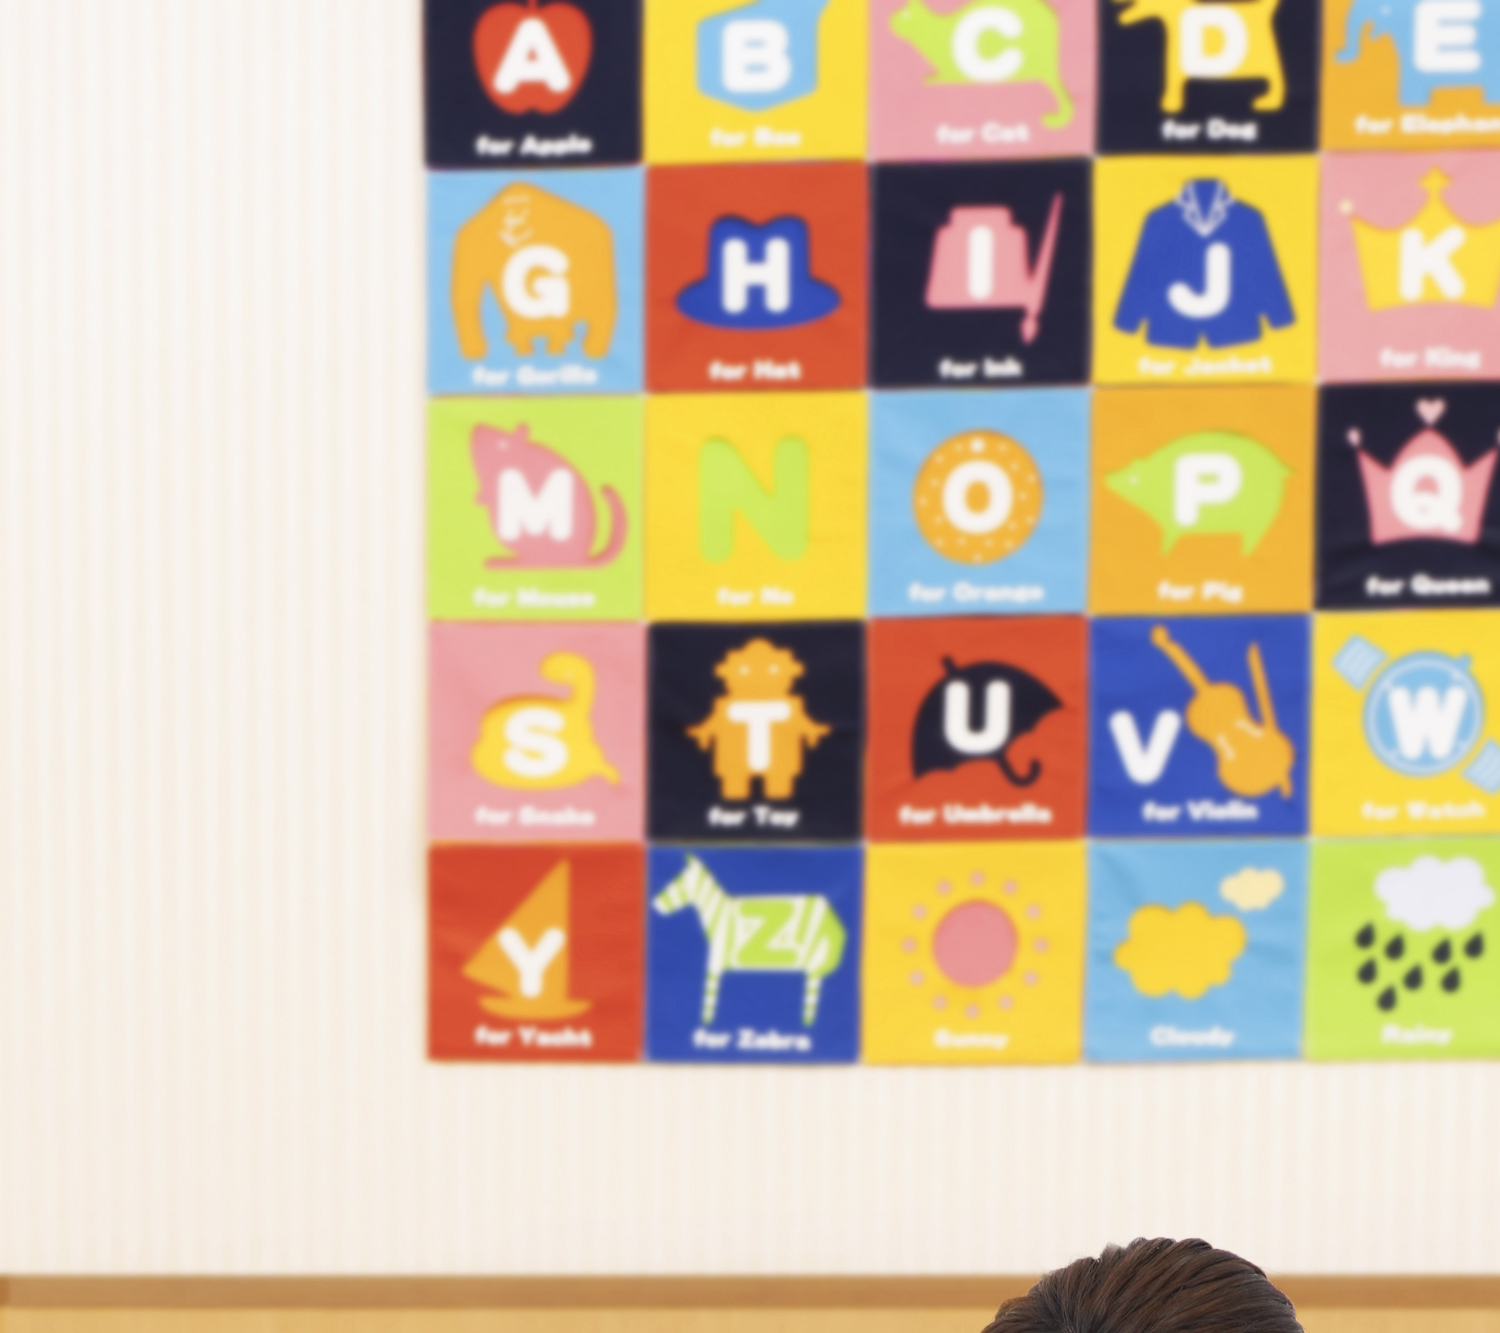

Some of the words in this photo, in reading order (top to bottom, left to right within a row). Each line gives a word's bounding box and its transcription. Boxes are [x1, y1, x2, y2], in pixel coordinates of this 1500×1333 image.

[951, 6, 1024, 82] C
[1179, 5, 1248, 78] D
[1413, 0, 1482, 72] E
[494, 18, 571, 94] A
[722, 20, 792, 92] B
[937, 123, 975, 145] for
[983, 123, 1029, 145] Cat
[1163, 120, 1201, 143] for
[1209, 120, 1256, 143] Dog
[1356, 114, 1393, 137] for
[476, 135, 513, 157] for
[521, 135, 591, 157] Apple
[710, 128, 748, 148] for
[968, 224, 993, 301] I
[1399, 226, 1466, 301] K
[502, 244, 570, 318] G
[722, 237, 790, 314] H
[1167, 243, 1230, 317] J
[710, 360, 747, 381] for
[755, 360, 800, 381] Hat
[940, 358, 978, 378] for
[985, 358, 1022, 378] Ink
[1140, 355, 1177, 376] for
[1381, 348, 1418, 371] for
[1427, 348, 1479, 371] King
[473, 365, 510, 387] for
[517, 365, 597, 387] Gorilla
[699, 435, 809, 563] N
[942, 460, 1013, 534] O
[1173, 453, 1243, 528] P
[1391, 453, 1464, 533] Q
[497, 467, 573, 542] M
[718, 586, 755, 607] for
[909, 581, 946, 604] for
[954, 581, 1042, 604] Orange
[1158, 581, 1195, 603] for
[1204, 581, 1242, 603] Pig
[1367, 575, 1404, 596] for
[1412, 575, 1489, 596] Queen
[474, 588, 511, 608] for
[944, 680, 1011, 754] U
[1387, 685, 1468, 760] W
[502, 705, 569, 778] S
[726, 700, 792, 773] T
[1109, 710, 1182, 785] V
[476, 806, 512, 827] for
[710, 806, 746, 829] for
[754, 806, 798, 829] Toy
[900, 804, 937, 825] for
[945, 804, 1051, 825] Umbrella
[1143, 800, 1180, 822] for
[1188, 800, 1258, 822] Violin
[1363, 799, 1400, 821] for
[734, 900, 798, 968] Z
[497, 927, 566, 1000] Y
[476, 1025, 513, 1048] for
[520, 1025, 592, 1048] Yacht
[694, 1029, 731, 1051] for
[738, 1029, 810, 1051] Zebra
[935, 1029, 1008, 1050] Sunny
[1151, 1025, 1235, 1047] Cloudy
[1382, 1025, 1452, 1047] Rainy
